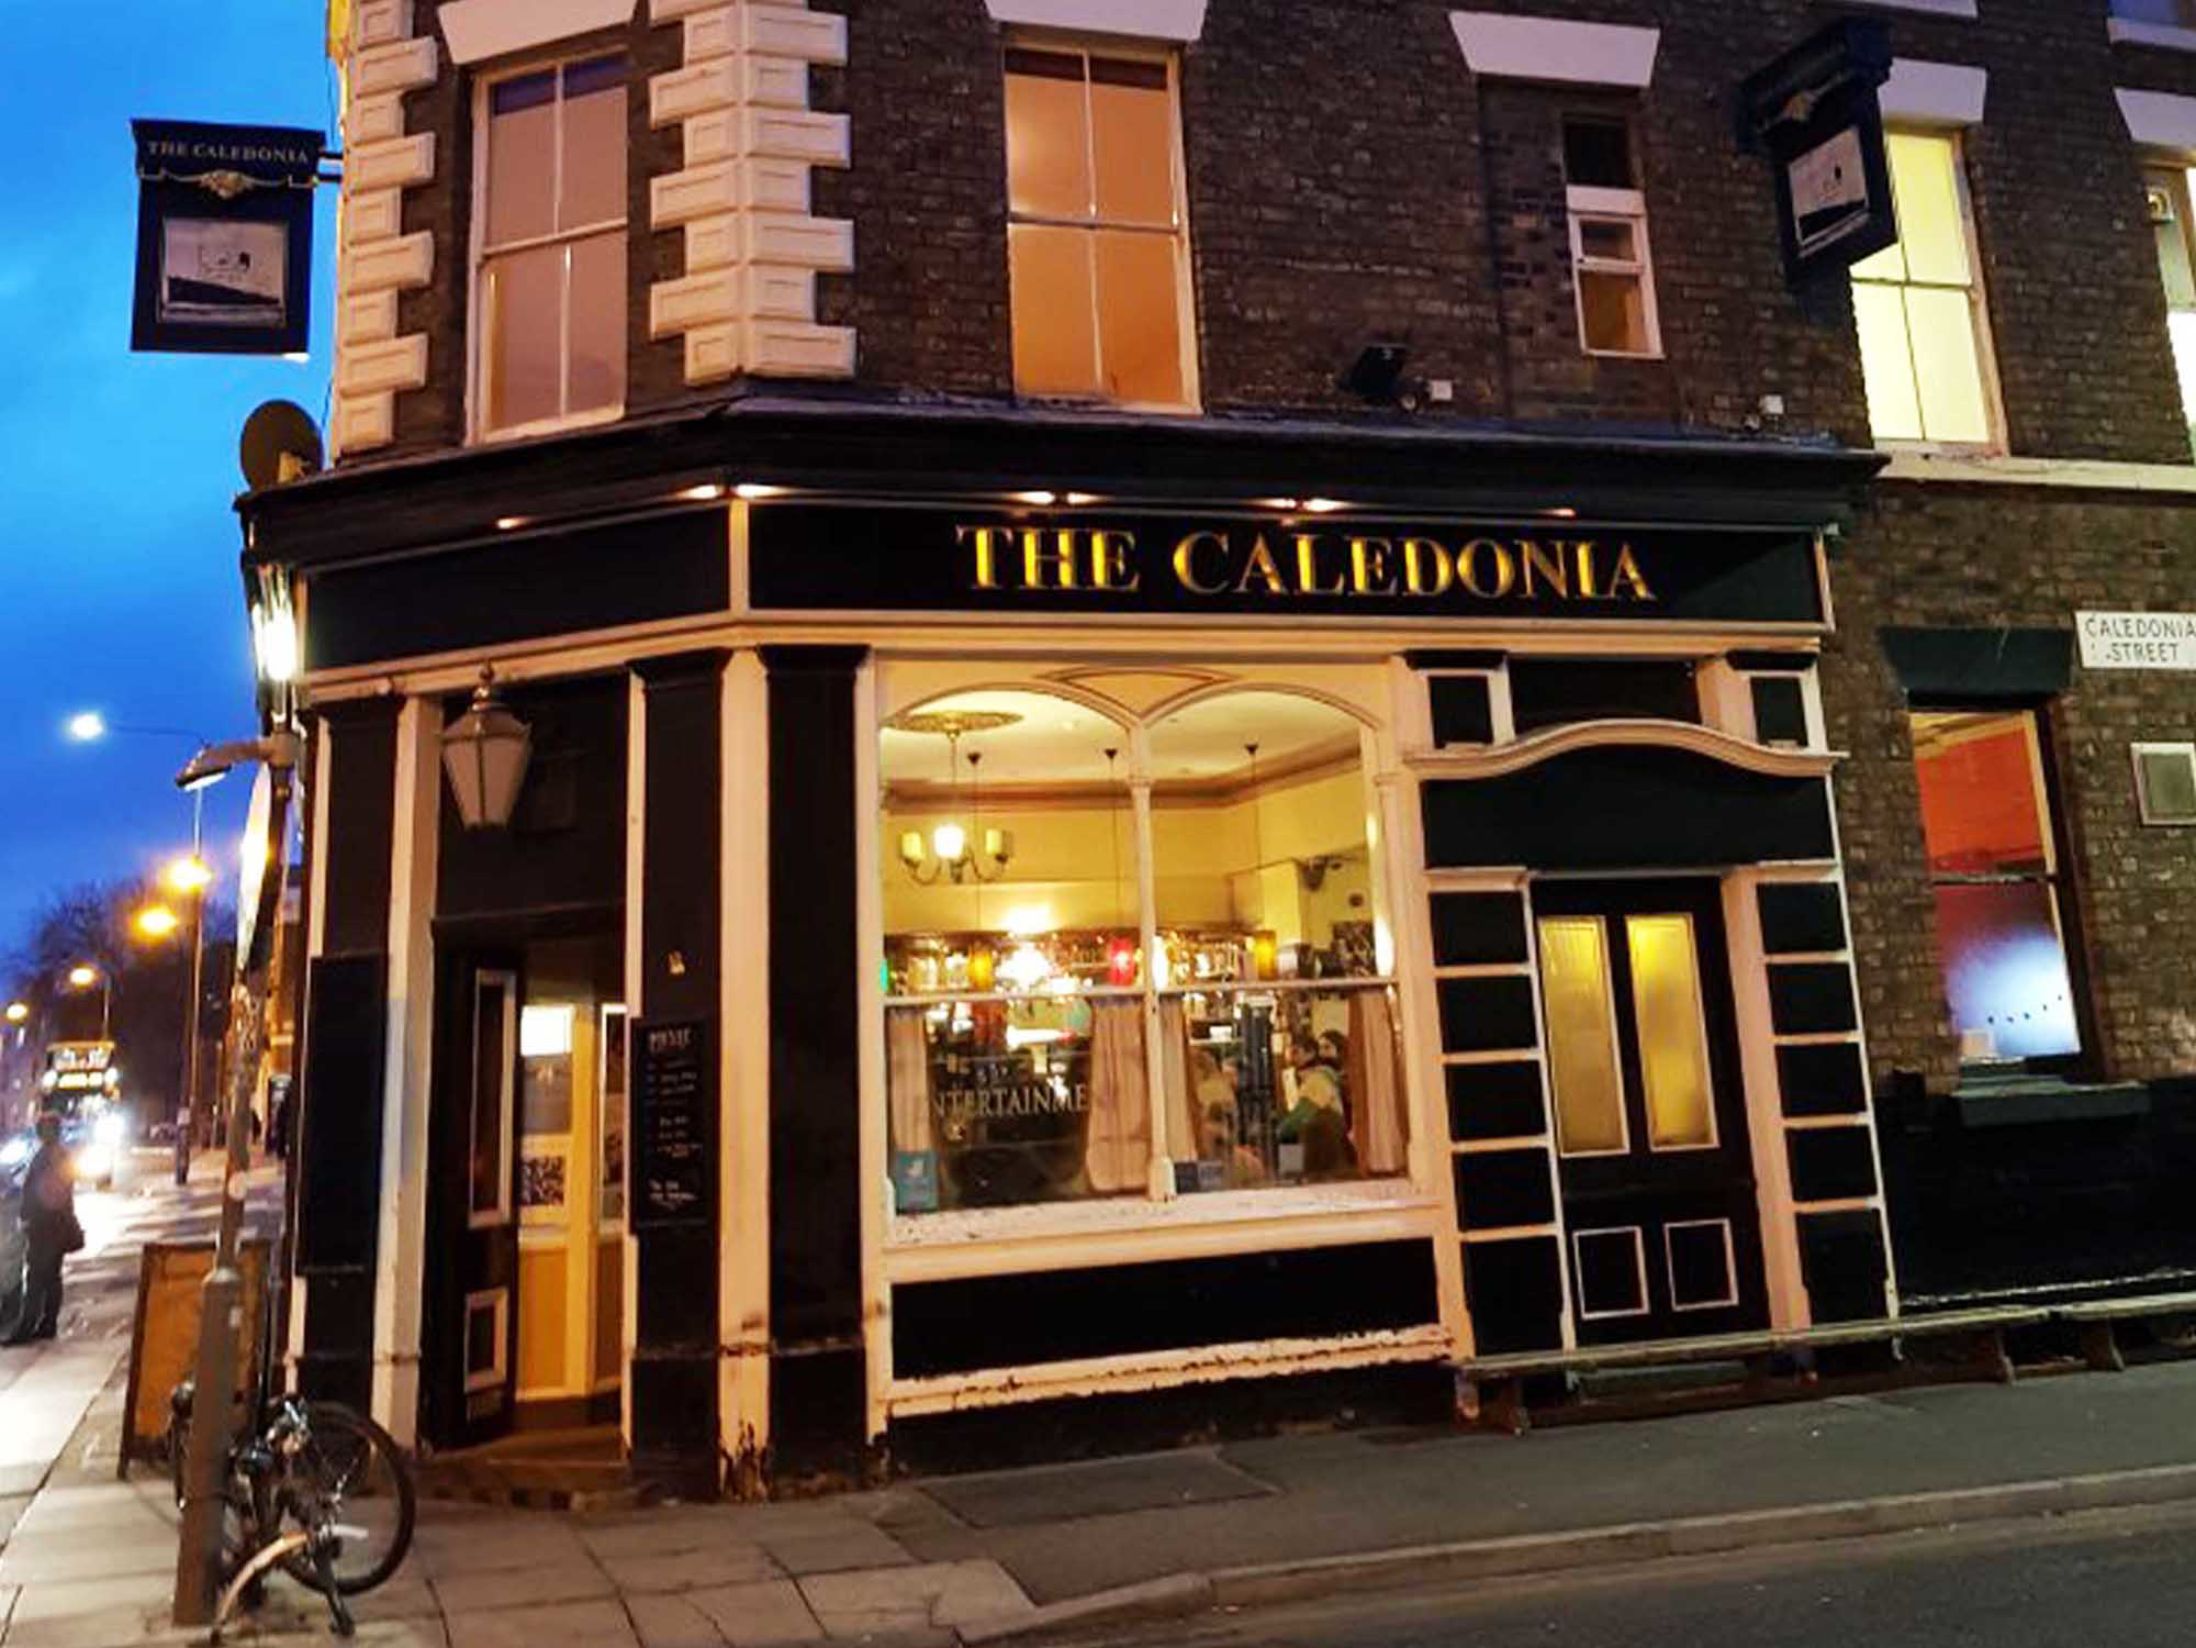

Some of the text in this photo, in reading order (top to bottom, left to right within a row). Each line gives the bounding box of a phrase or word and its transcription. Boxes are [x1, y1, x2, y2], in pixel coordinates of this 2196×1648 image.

[147, 140, 308, 163] THE CALEDONIA
[955, 524, 1657, 601] THE CALEDONIA
[2085, 617, 2196, 637] CALEDONIA
[2111, 642, 2178, 662] STREET
[933, 1083, 1089, 1118] NTERTAINME
